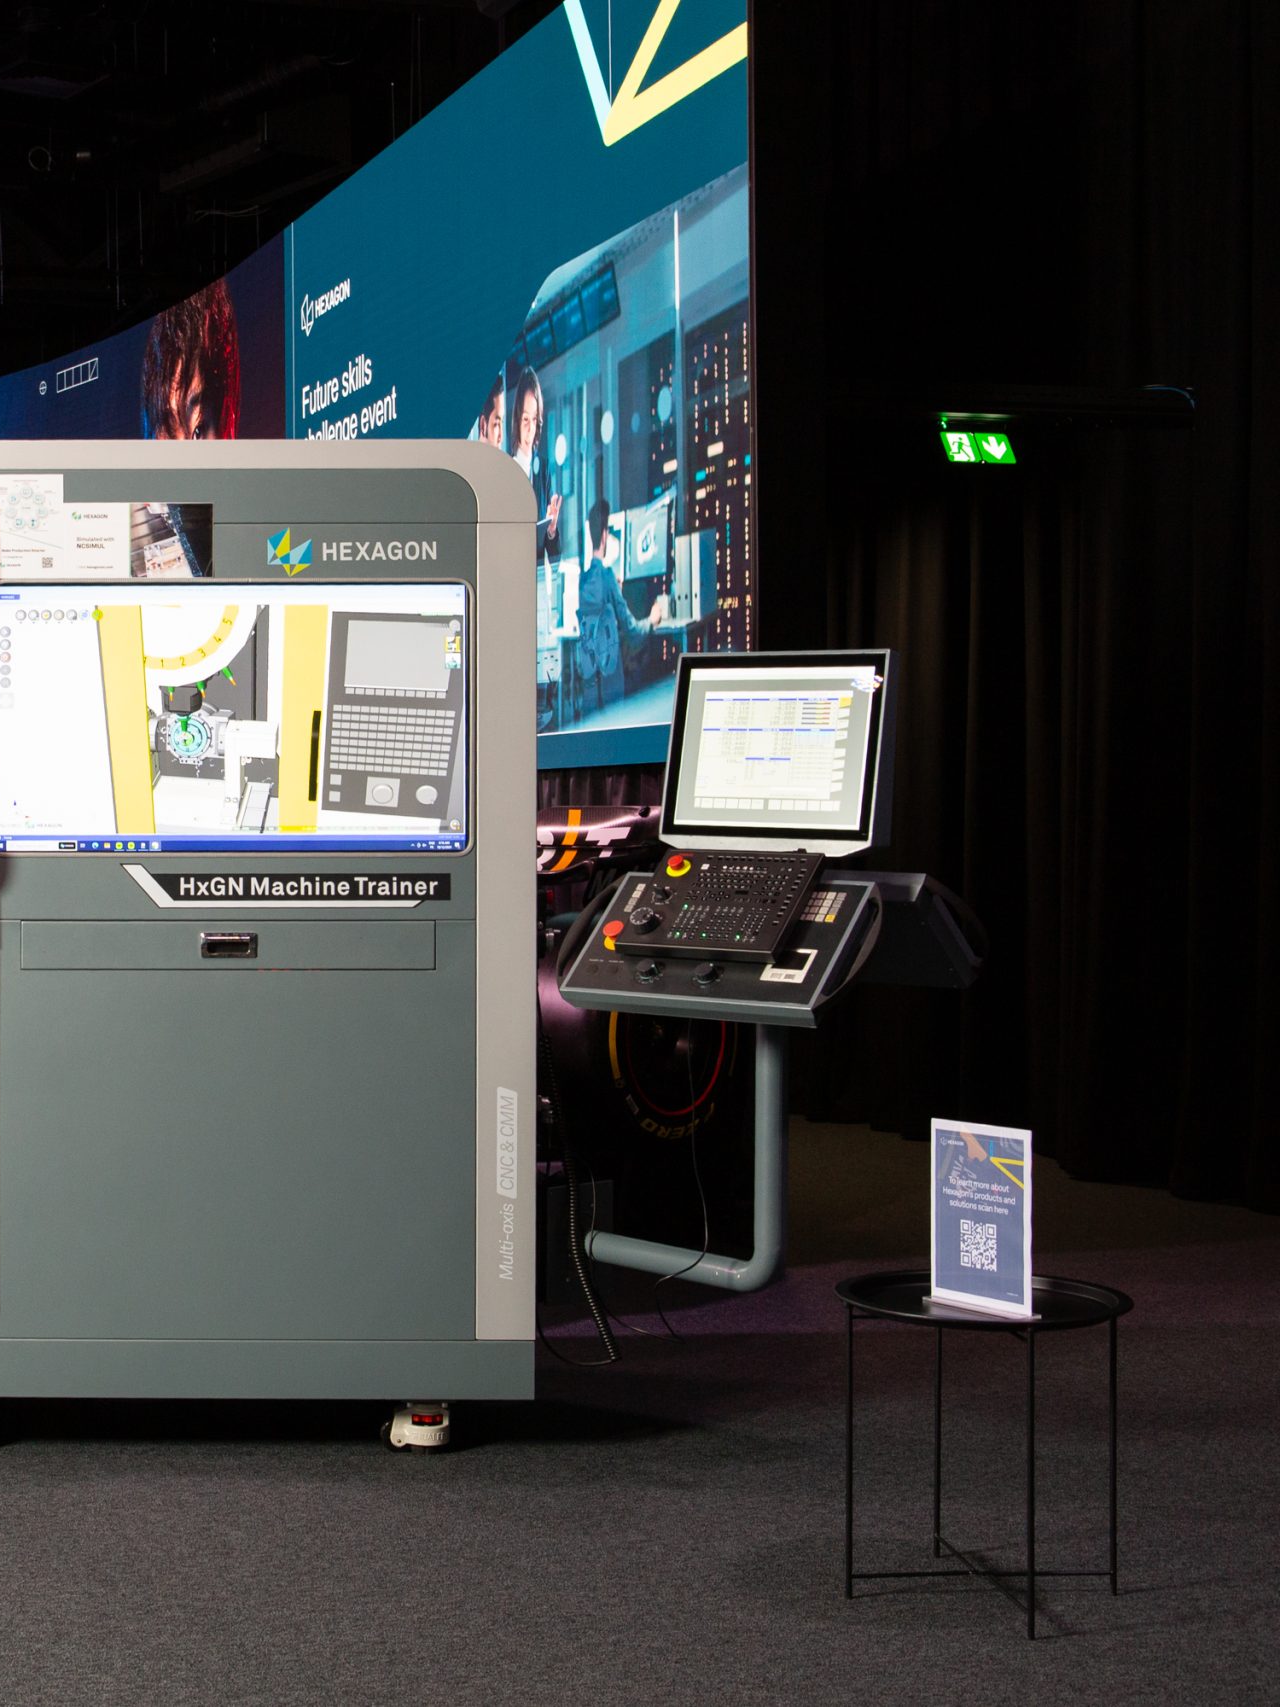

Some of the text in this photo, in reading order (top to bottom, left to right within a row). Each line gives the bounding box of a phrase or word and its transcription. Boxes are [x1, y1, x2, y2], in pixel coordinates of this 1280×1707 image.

[315, 278, 351, 318] HEXAGON
[302, 353, 372, 419] Future skills
[304, 385, 397, 440] hallenge event
[83, 512, 109, 520] HEXAGON
[322, 541, 438, 562] HEXAGON
[179, 876, 438, 896] HxGN Machine Trainer
[500, 1095, 515, 1191] CNC & CMM
[973, 1181, 990, 1191] more
[990, 1182, 1010, 1194] about
[949, 1199, 1009, 1216] solutions scan here
[974, 1191, 1003, 1203] products
[1003, 1196, 1016, 1206] and
[498, 1203, 514, 1281] Multi-axis
